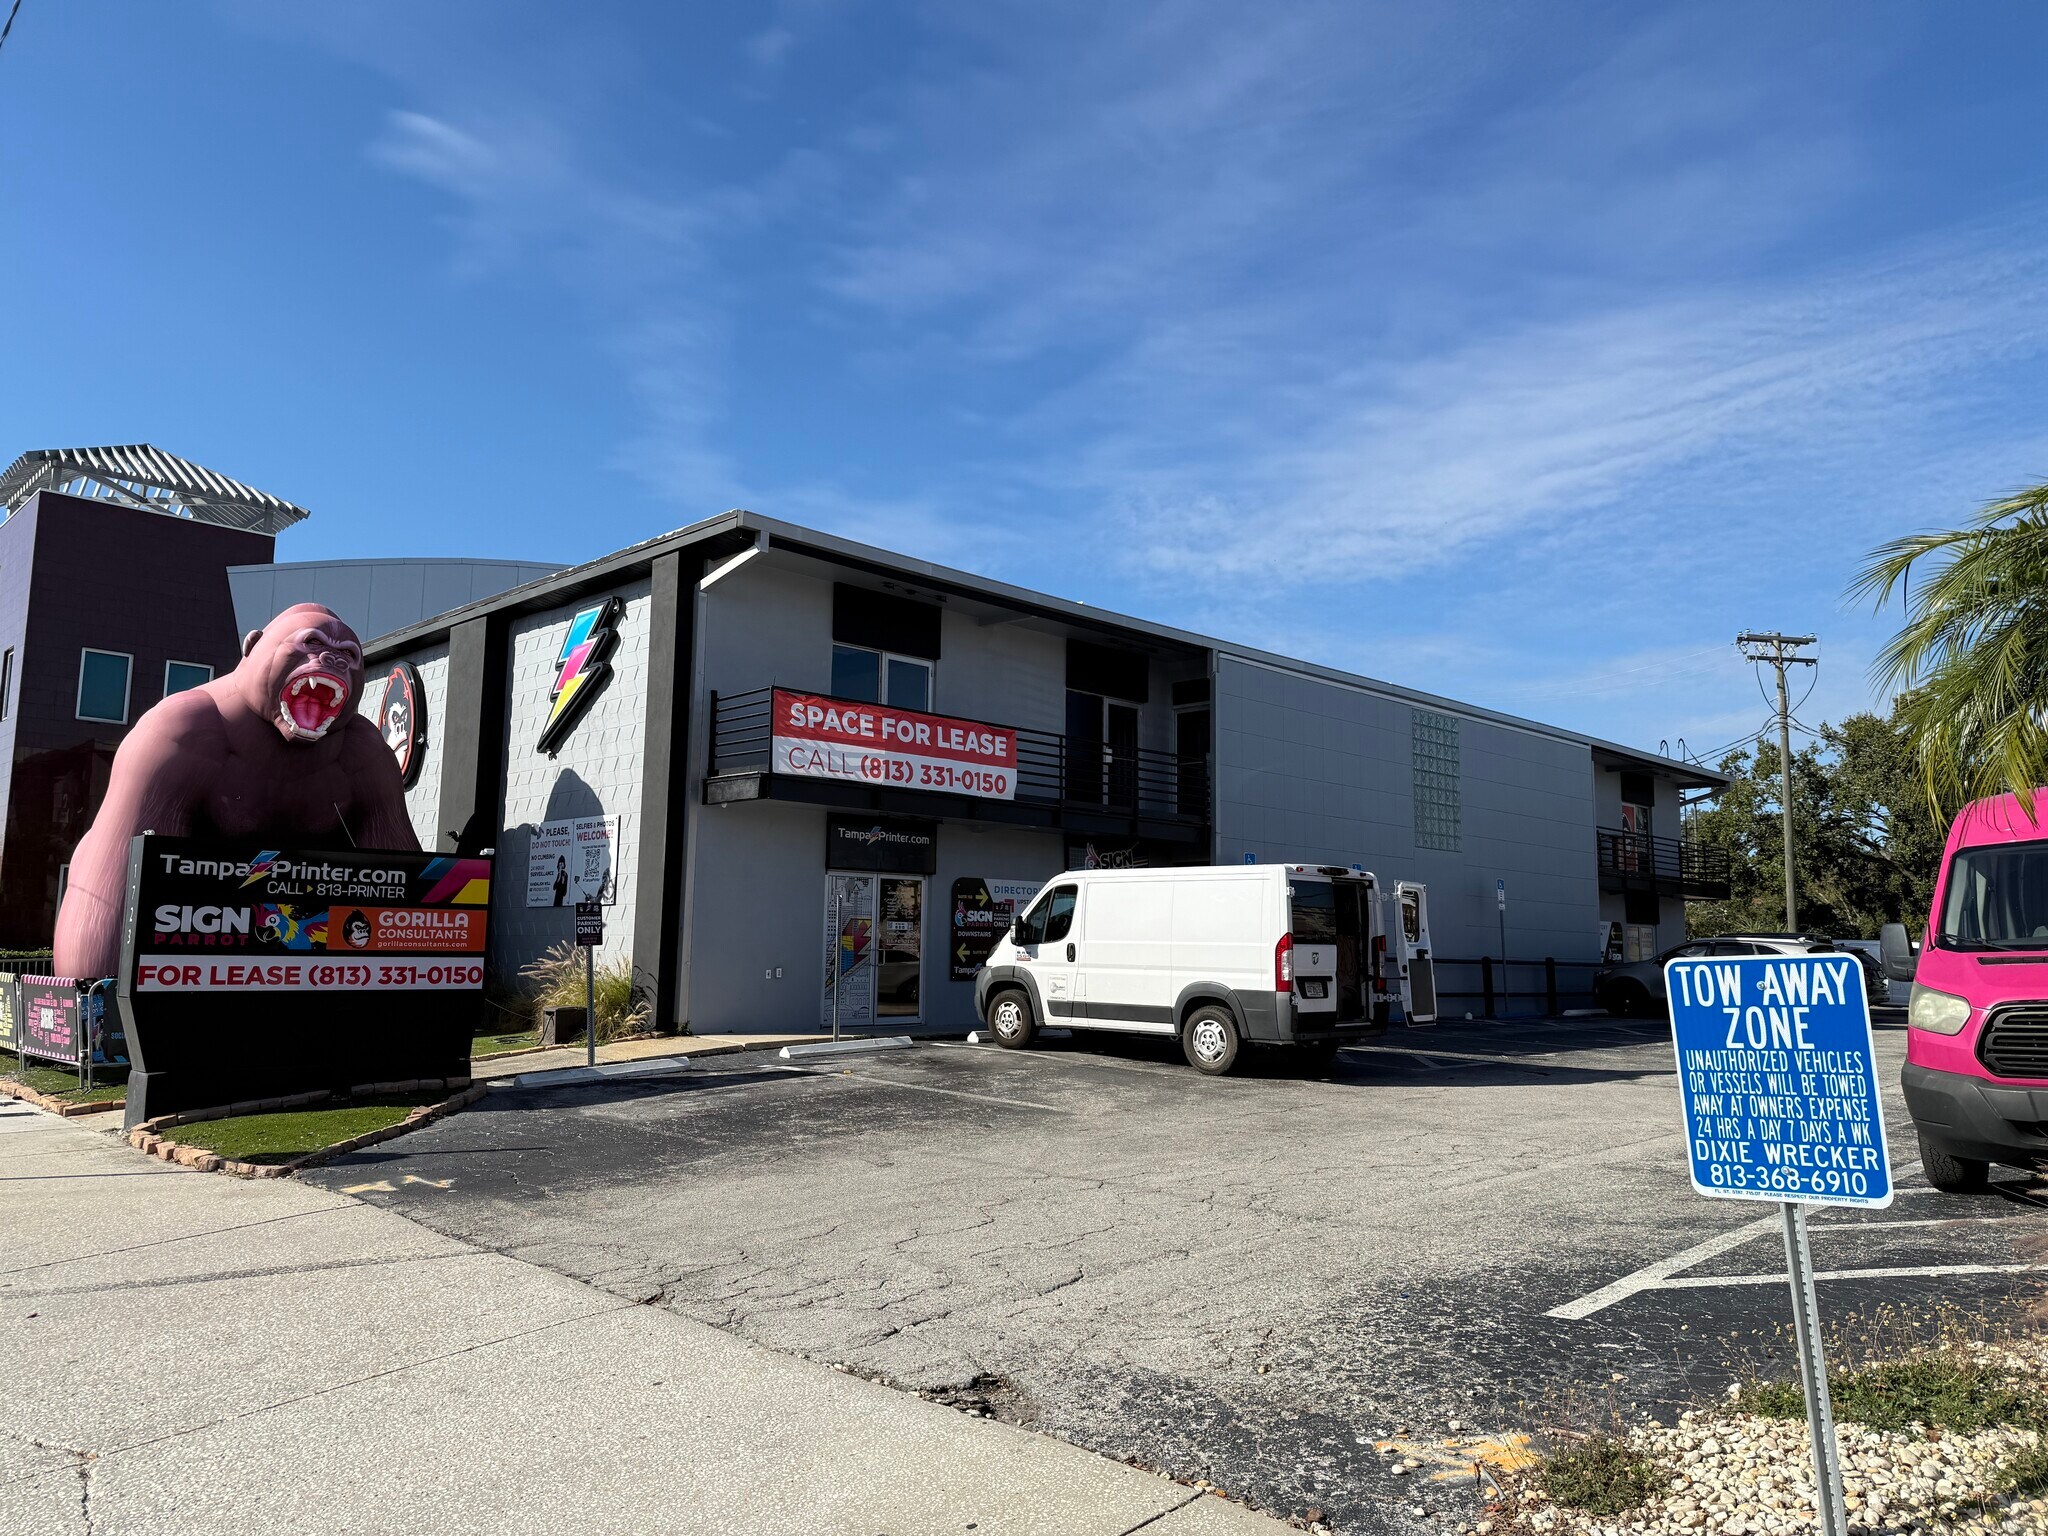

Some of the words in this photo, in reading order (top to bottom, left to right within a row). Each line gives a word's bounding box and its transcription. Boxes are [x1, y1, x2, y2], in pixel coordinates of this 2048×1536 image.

[789, 702, 874, 738] SPACE
[882, 717, 931, 746] FOR
[937, 726, 1007, 757] LEASE
[788, 747, 854, 775] CALL
[860, 754, 913, 784] (813)
[920, 764, 1007, 794] 331-0150
[545, 826, 570, 837] PLEASE,
[576, 822, 593, 830] SELFIES
[596, 820, 615, 829] PHOTOS
[576, 829, 614, 842] WELCOME!
[531, 841, 539, 849] DO
[540, 840, 551, 849] NOT
[551, 838, 571, 848] TOUCH!
[1100, 849, 1133, 869] SIGN
[267, 881, 304, 895] CALL
[316, 883, 405, 899] 813-PRINTER
[154, 904, 251, 934] SIGN
[378, 911, 469, 928] GORILLA
[967, 910, 993, 923] SIGN
[154, 933, 249, 945] PARROT
[377, 928, 468, 940] CONSULTANTS
[577, 926, 602, 934] ONLY
[958, 930, 992, 938] DOWNSTAIRS
[137, 965, 201, 986] FOR
[209, 965, 302, 986] LEASE
[308, 964, 371, 987] (813)
[377, 966, 483, 985] 331-0150
[1675, 964, 1742, 1007] TOW
[1762, 961, 1849, 1006] AWAY
[1722, 1005, 1815, 1050] ZONE
[1686, 1049, 1788, 1072] UNAUTHORIZED
[1794, 1050, 1864, 1074] VEHICLES
[1689, 1071, 1706, 1093] OR
[1710, 1072, 1763, 1095] VESSELS
[1767, 1073, 1797, 1096] WILL
[1801, 1074, 1818, 1096] BE
[1822, 1074, 1867, 1098] TOWED
[1693, 1094, 1724, 1116] AWAY
[1730, 1095, 1743, 1117] AT
[1749, 1095, 1804, 1119] OWNERS
[1809, 1098, 1871, 1122] EXPENSE
[1696, 1117, 1712, 1139] 24
[1716, 1118, 1741, 1140] HRS
[1747, 1118, 1756, 1140] A
[1760, 1119, 1781, 1141] DAY
[1786, 1120, 1795, 1142] 7
[1800, 1120, 1832, 1144] DAYS
[1838, 1122, 1847, 1145] A
[1850, 1122, 1872, 1146] WK
[1695, 1139, 1753, 1164] DIXIE
[1763, 1143, 1880, 1171] WRECKER
[1710, 1163, 1867, 1196] 813-368-6910
